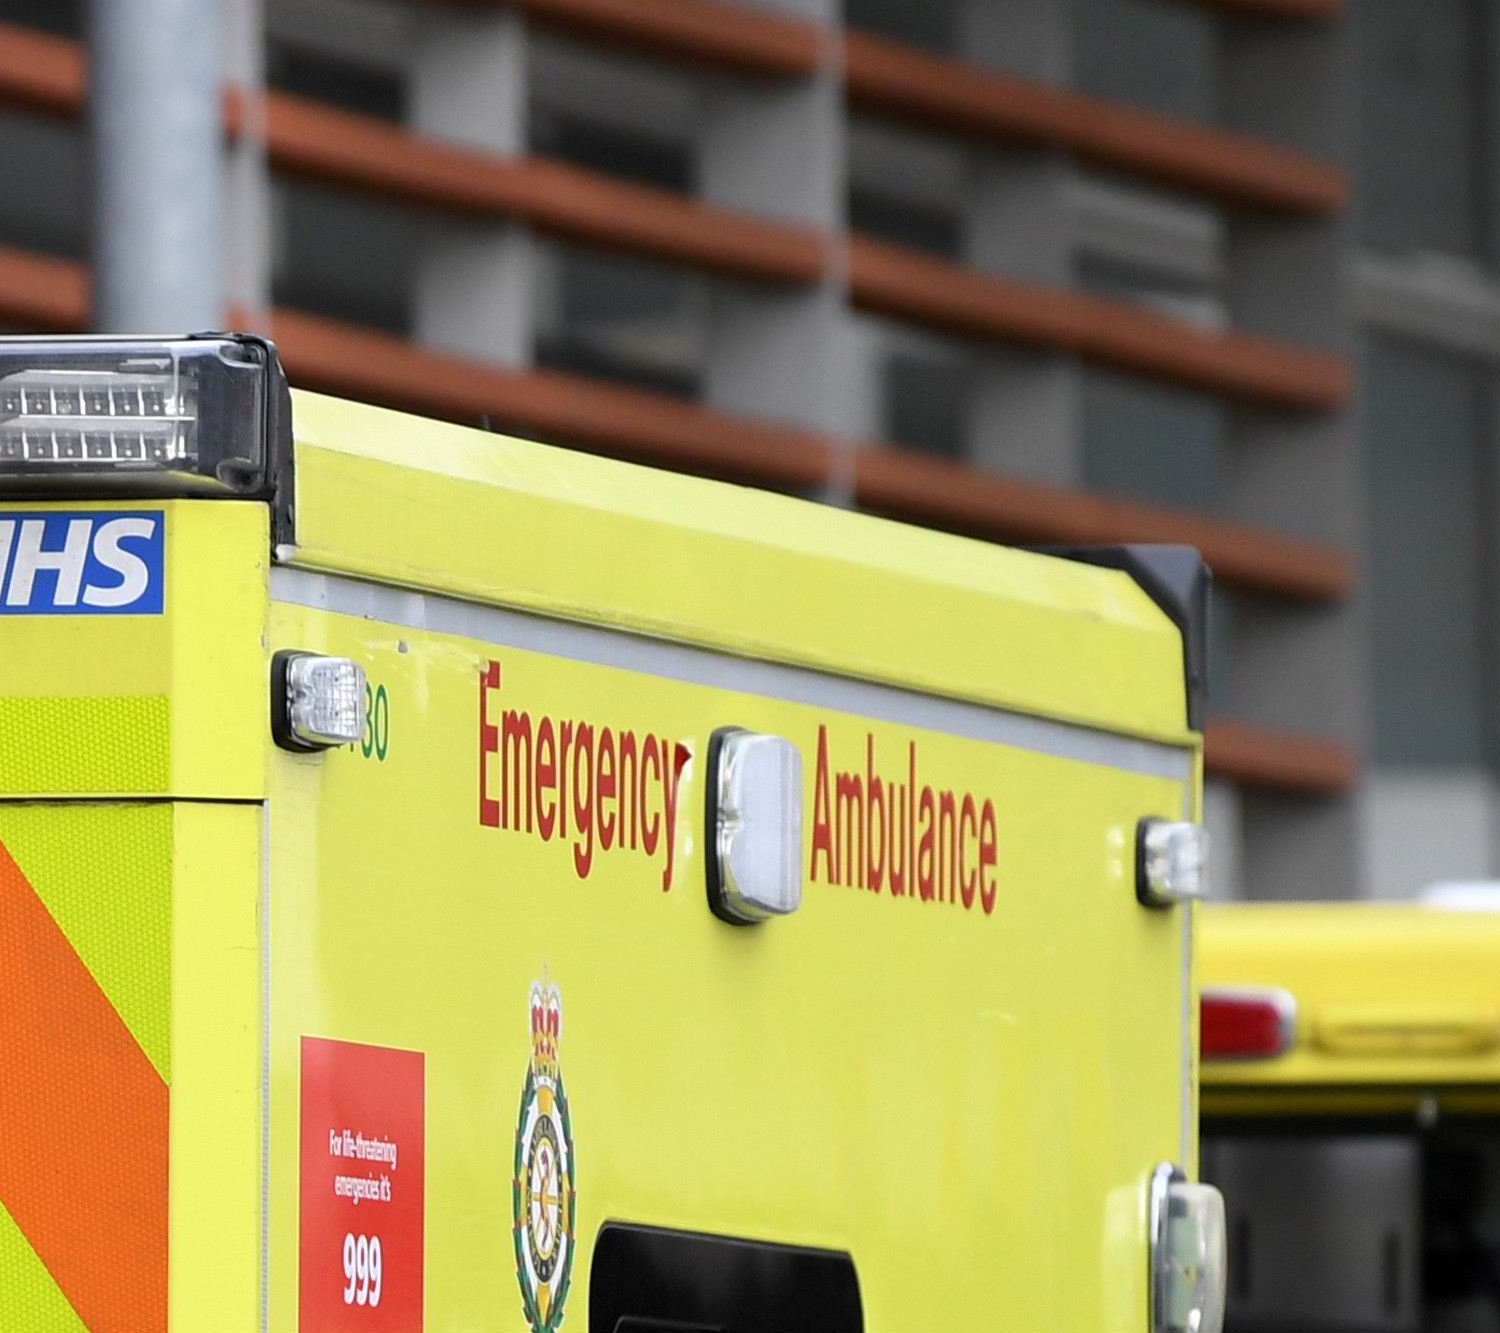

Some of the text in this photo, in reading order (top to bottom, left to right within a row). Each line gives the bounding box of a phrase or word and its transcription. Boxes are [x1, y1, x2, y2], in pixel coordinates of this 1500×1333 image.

[478, 660, 998, 916] Emergency Ambulance
[328, 1128, 342, 1157] For
[342, 1232, 383, 1307] 999
